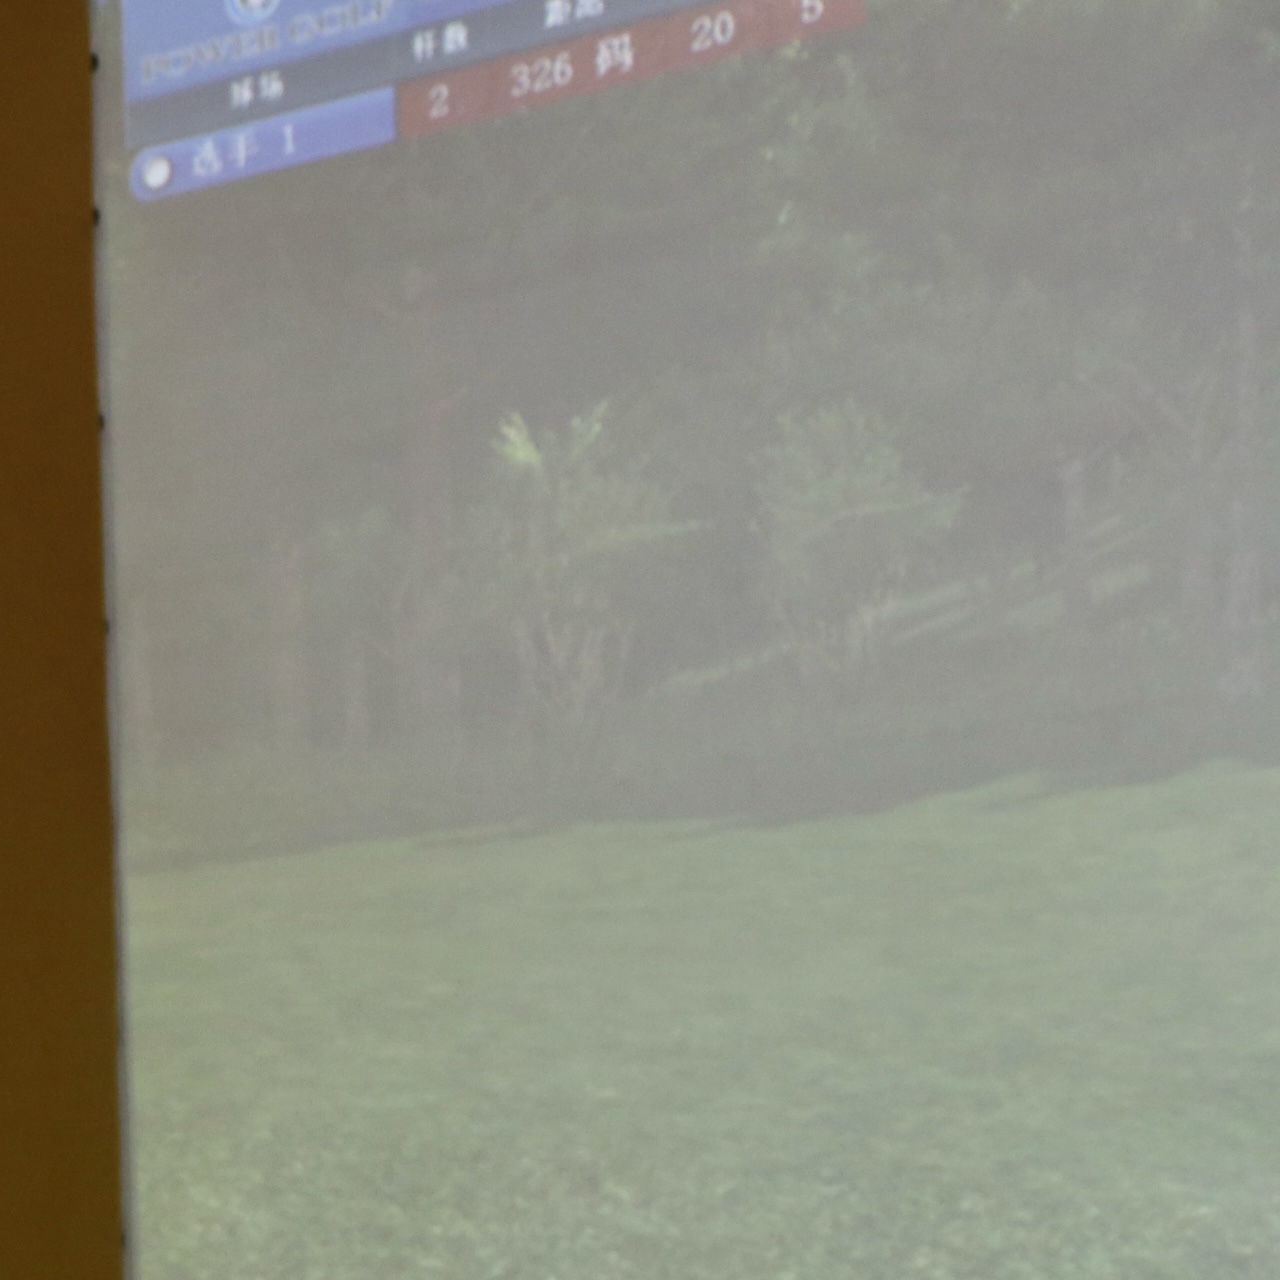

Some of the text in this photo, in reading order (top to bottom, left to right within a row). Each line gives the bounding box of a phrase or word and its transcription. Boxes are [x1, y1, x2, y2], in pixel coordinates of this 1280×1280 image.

[429, 82, 450, 120] 2
[510, 51, 574, 98] 326
[691, 9, 736, 53] 20
[800, 0, 825, 24] 5
